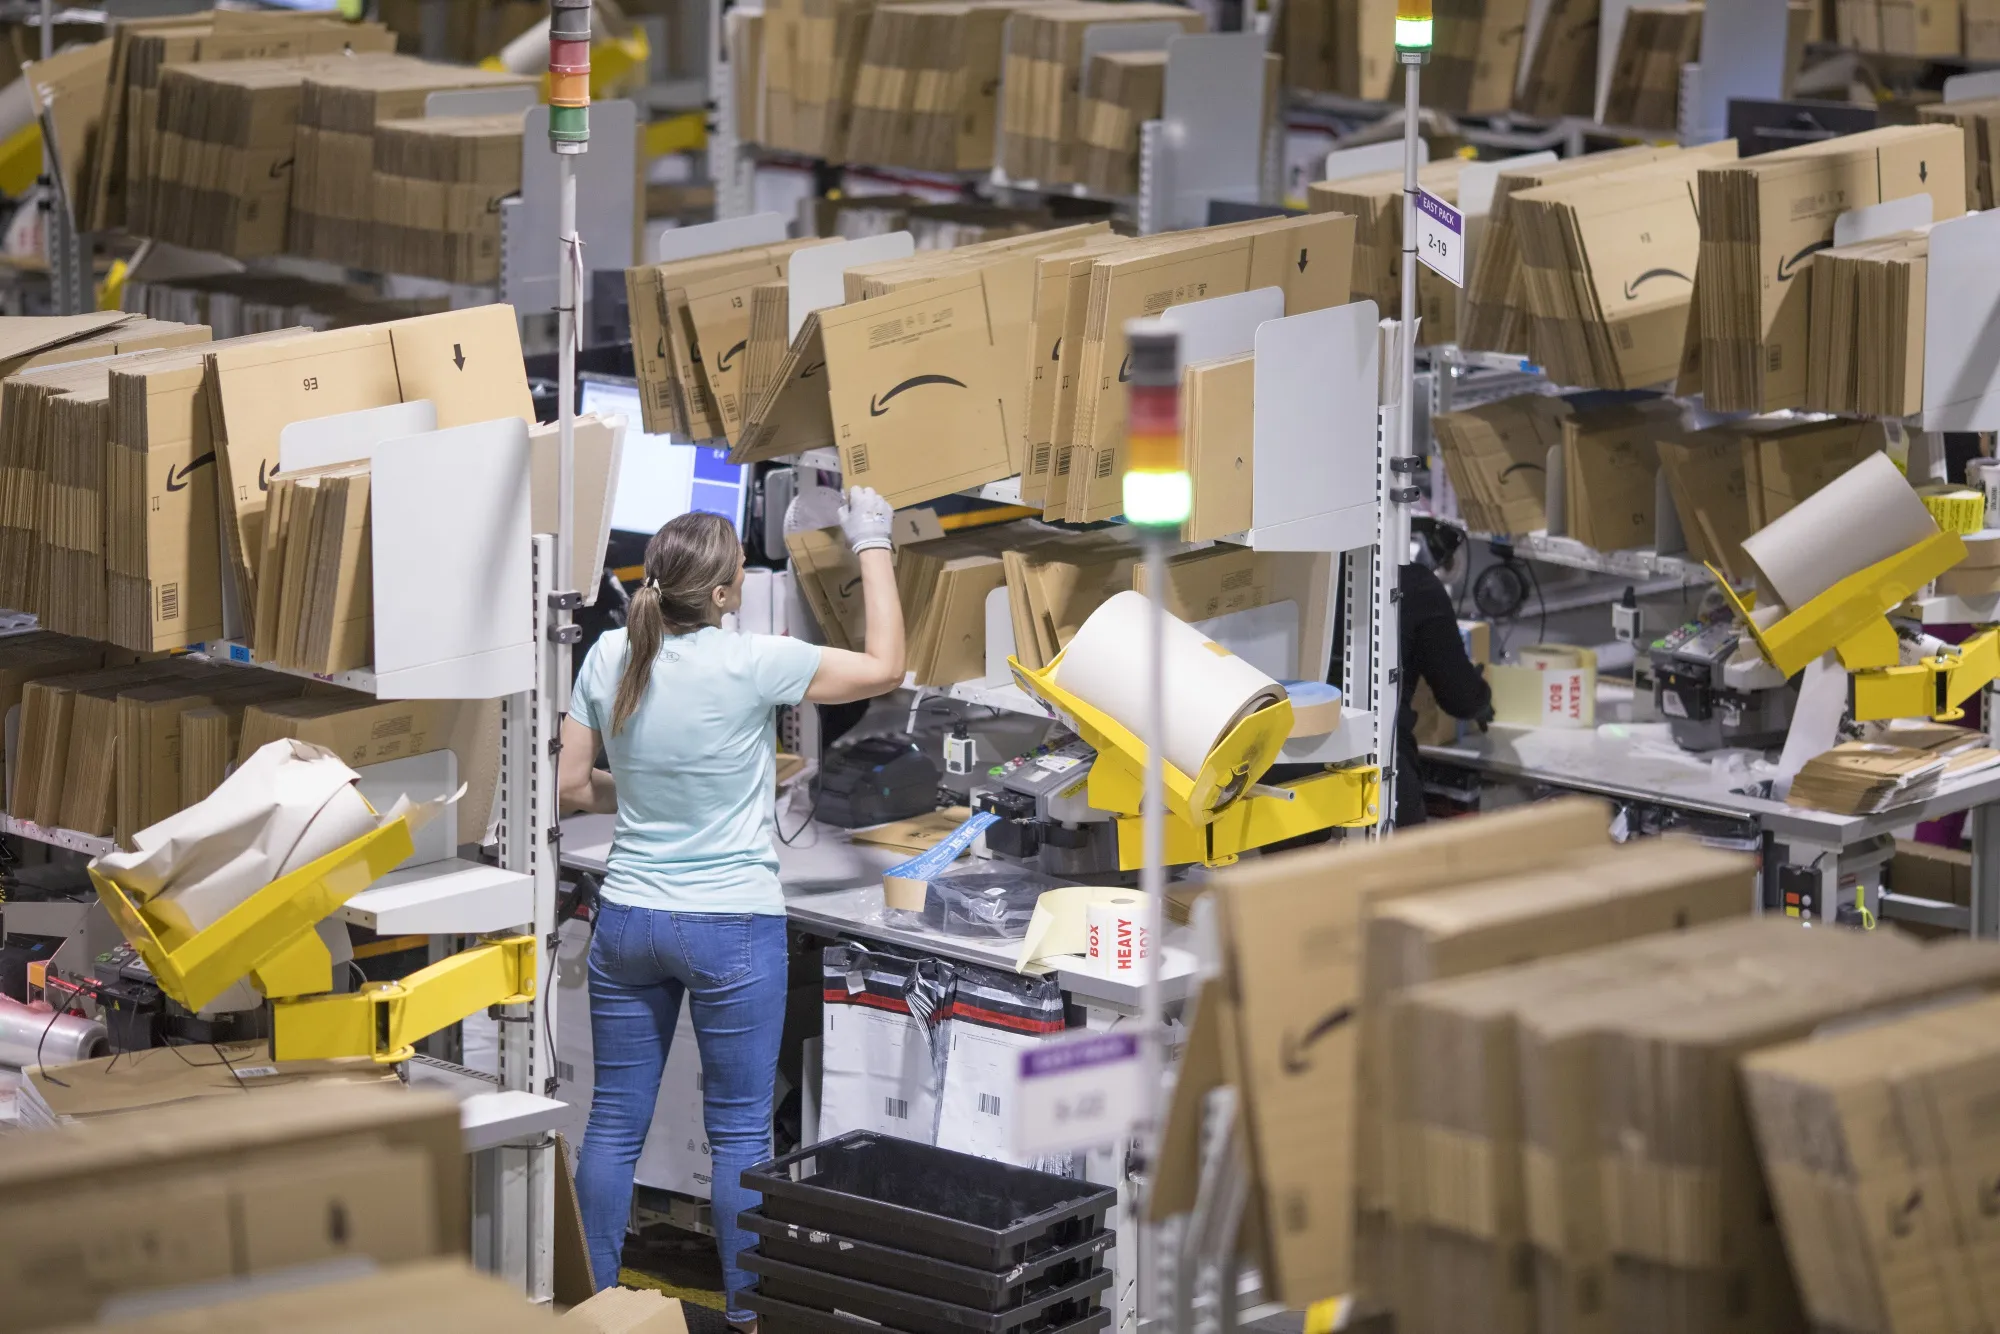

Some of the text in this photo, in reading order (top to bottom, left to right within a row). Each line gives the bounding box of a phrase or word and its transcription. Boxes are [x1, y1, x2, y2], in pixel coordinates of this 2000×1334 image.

[1423, 196, 1455, 227] EAST PACK
[1428, 233, 1447, 257] 2-19
[303, 377, 318, 390] E6
[1549, 684, 1563, 713] BOX
[1569, 675, 1581, 719] HEAVY
[1089, 924, 1099, 958] BOX
[1117, 918, 1132, 970] HEAVY
[692, 1172, 712, 1184] amazo
